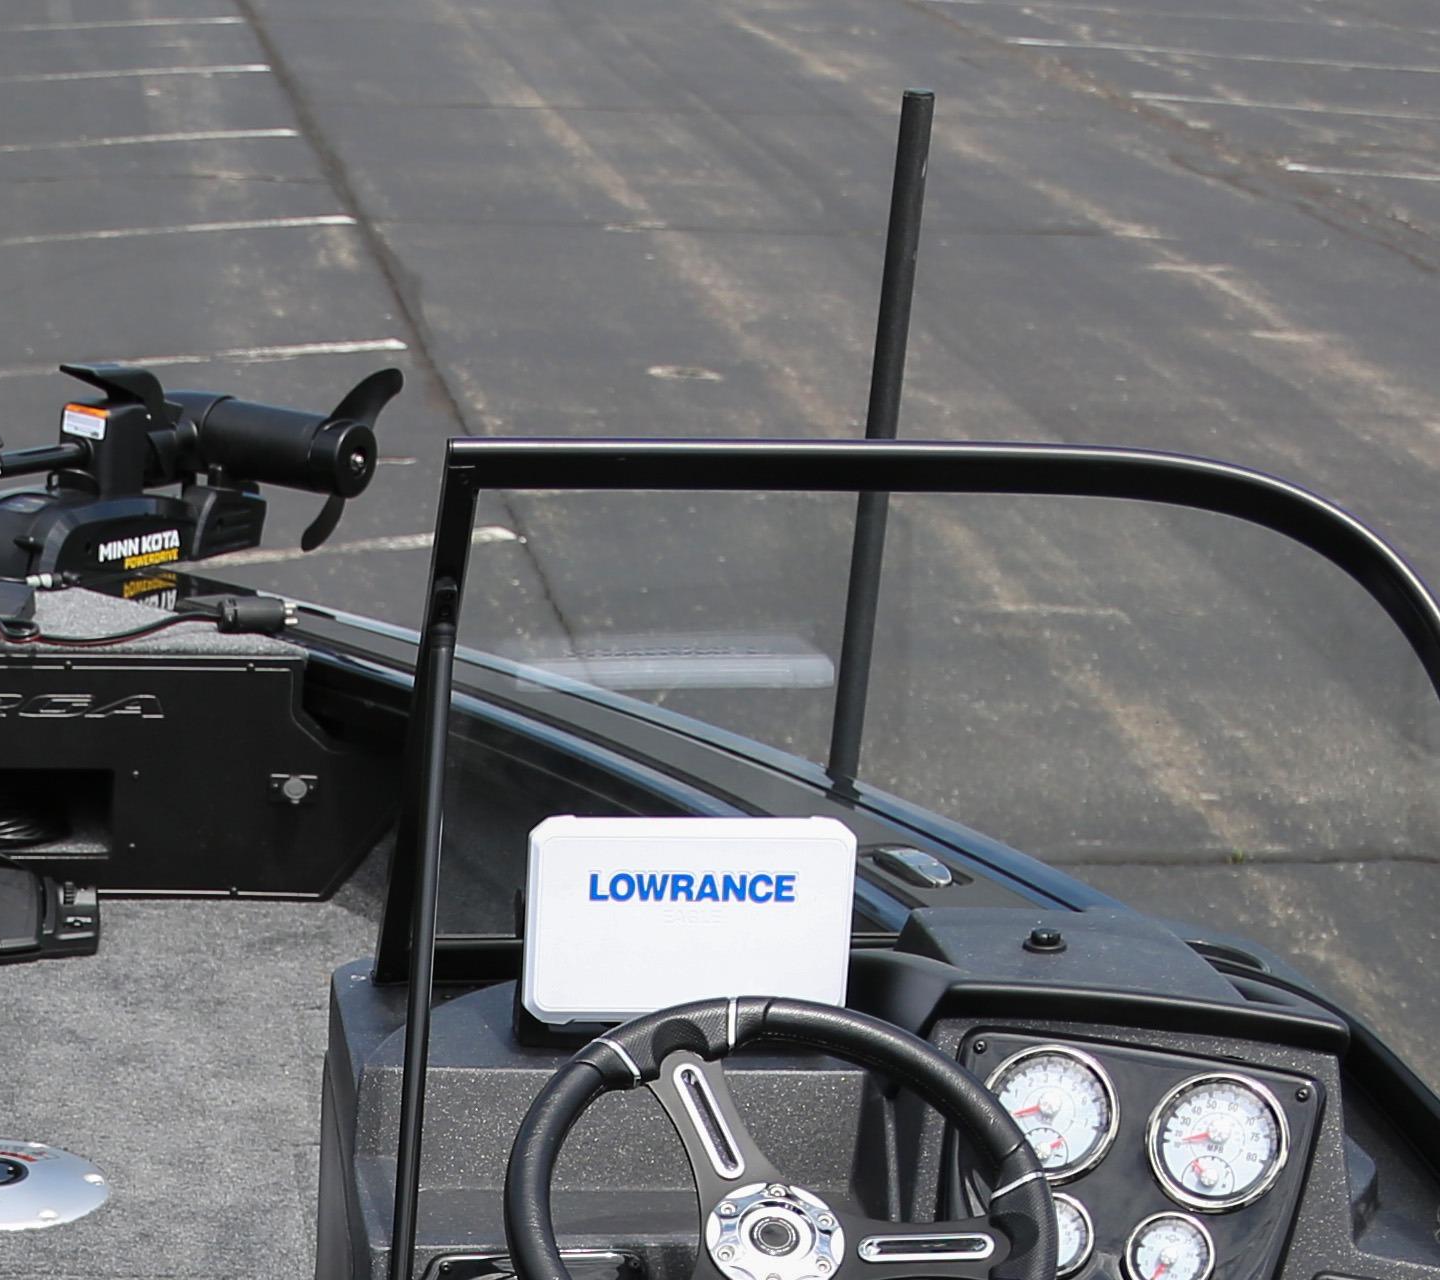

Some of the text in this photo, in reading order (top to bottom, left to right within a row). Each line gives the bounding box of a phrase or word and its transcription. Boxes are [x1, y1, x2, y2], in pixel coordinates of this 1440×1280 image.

[99, 529, 181, 562] MINN KOTA
[124, 548, 179, 570] POWERDRIVE
[588, 872, 797, 904] LOWRANCE
[1191, 1105, 1202, 1116] 40
[1206, 1100, 1217, 1110] 50
[1227, 1102, 1239, 1113] 60
[1180, 1117, 1191, 1127] 30
[1251, 1132, 1260, 1142] 75
[1246, 1152, 1258, 1162] 80
